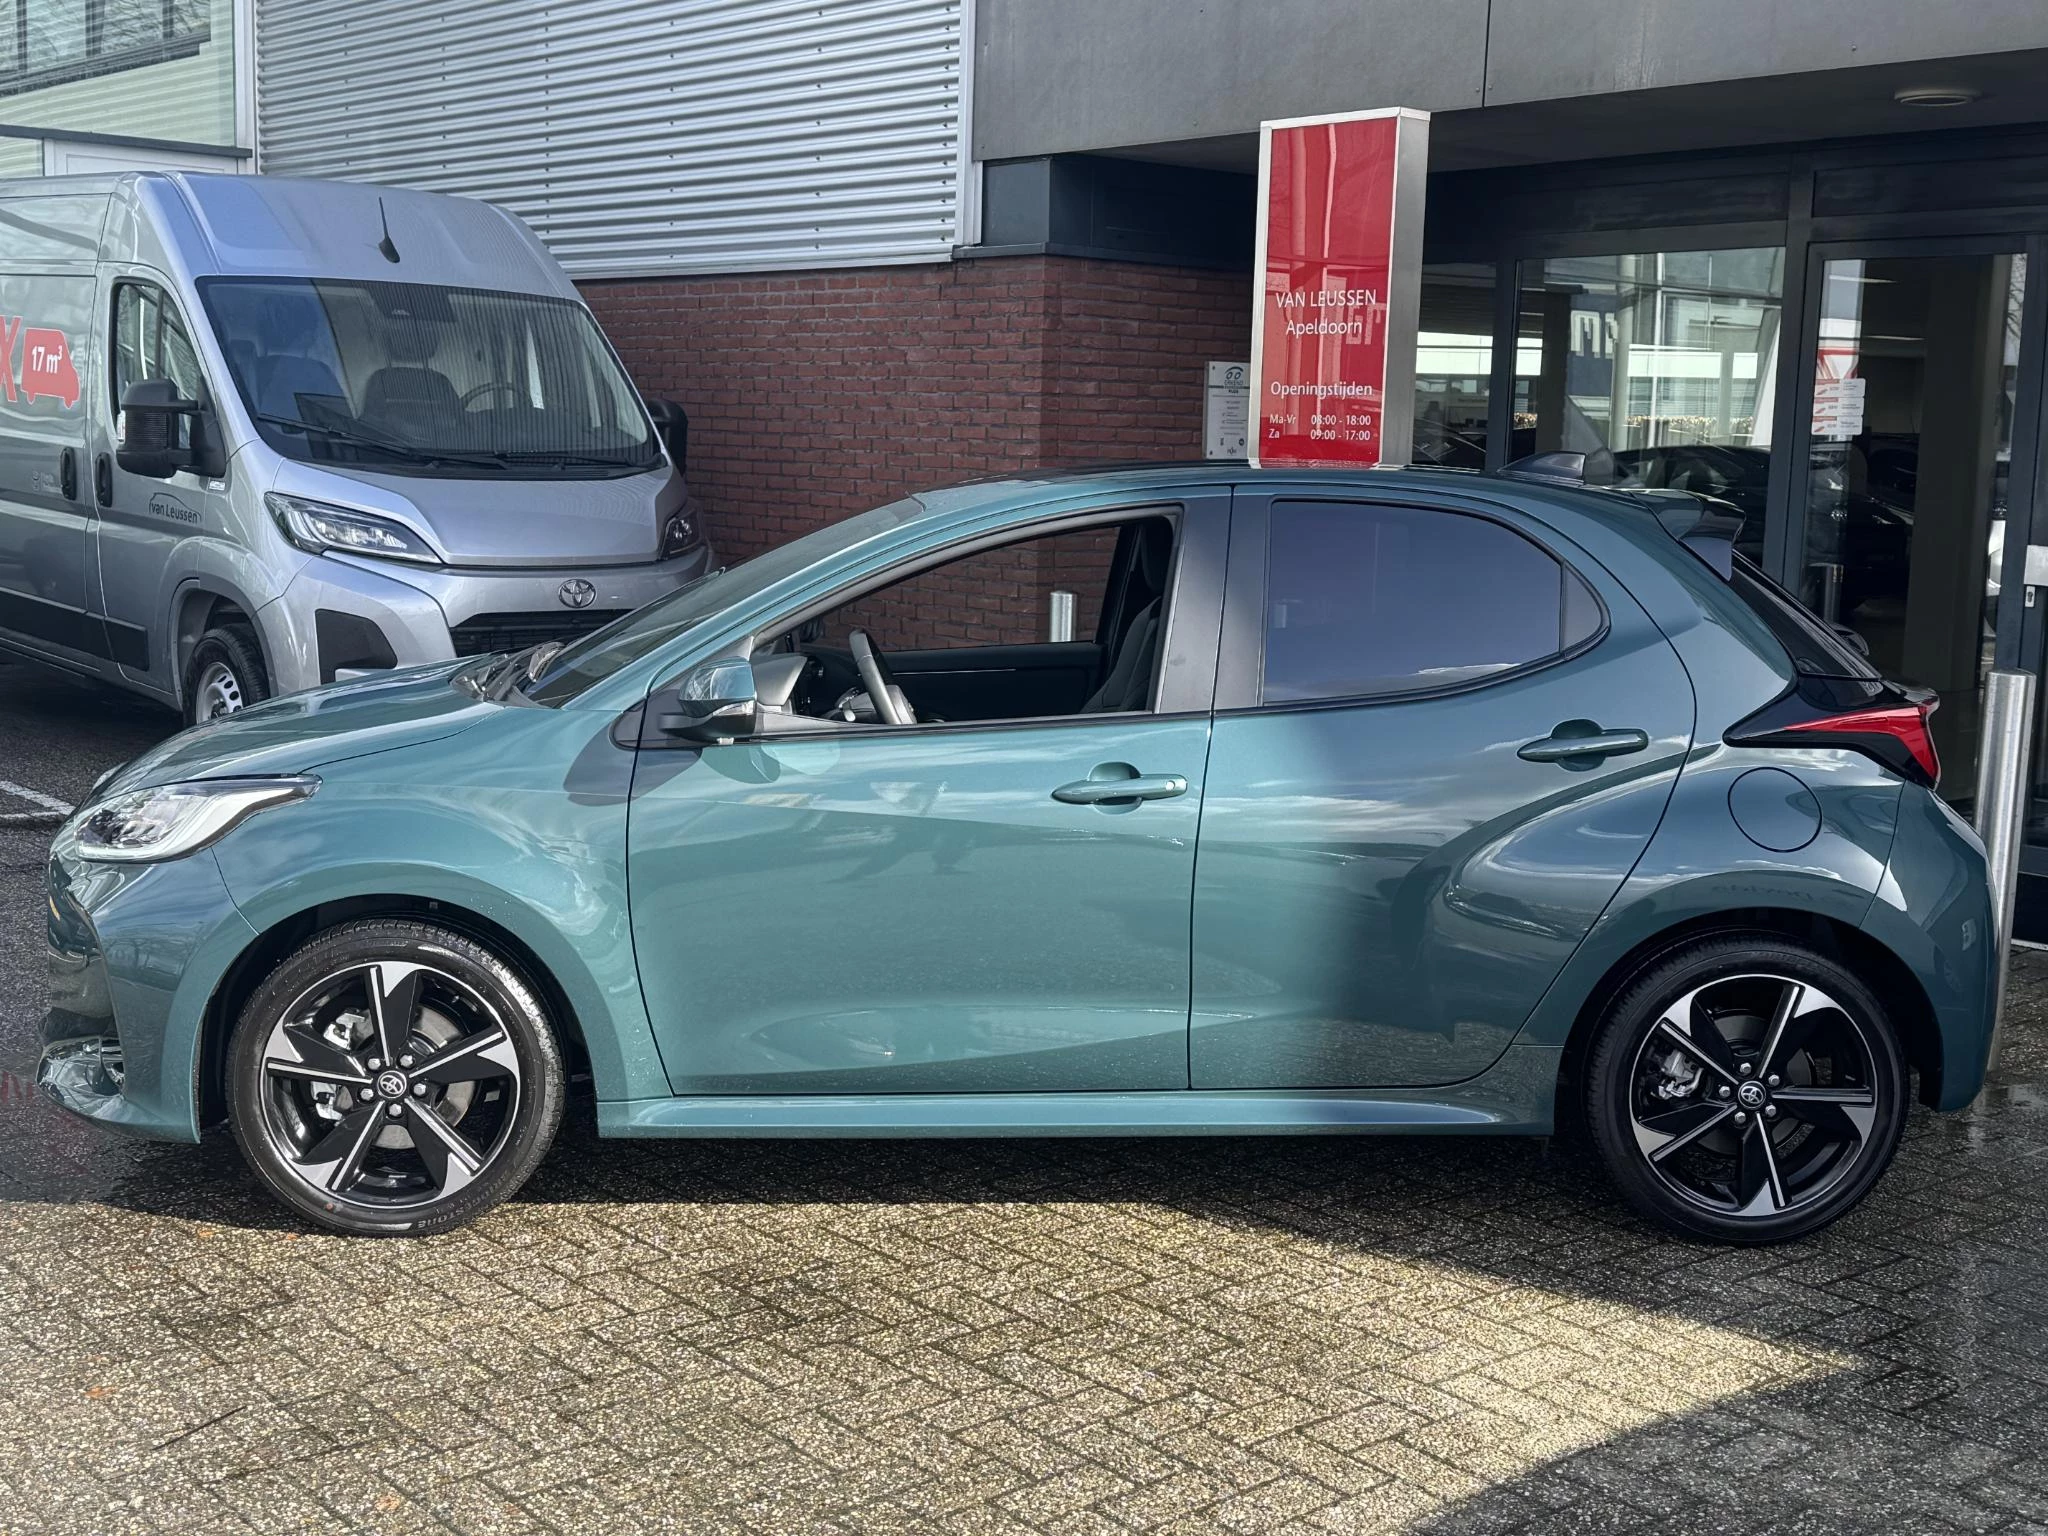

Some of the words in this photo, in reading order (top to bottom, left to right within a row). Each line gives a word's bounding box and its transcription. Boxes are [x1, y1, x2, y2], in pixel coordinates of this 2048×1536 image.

[1276, 291, 1306, 308] VAN
[1310, 289, 1377, 306] LEUSSEN
[1286, 318, 1362, 339] Apeldoorn
[32, 345, 45, 372] 17
[1270, 381, 1373, 399] Openingstijden
[1269, 414, 1297, 424] Ma-Vr
[1311, 415, 1336, 425] 08:00
[1346, 415, 1371, 425] 18:00
[1268, 428, 1280, 438] Za
[1310, 430, 1336, 440] 09:00
[1345, 430, 1371, 440] 17:00
[151, 503, 164, 515] van
[166, 504, 198, 524] Leussen
